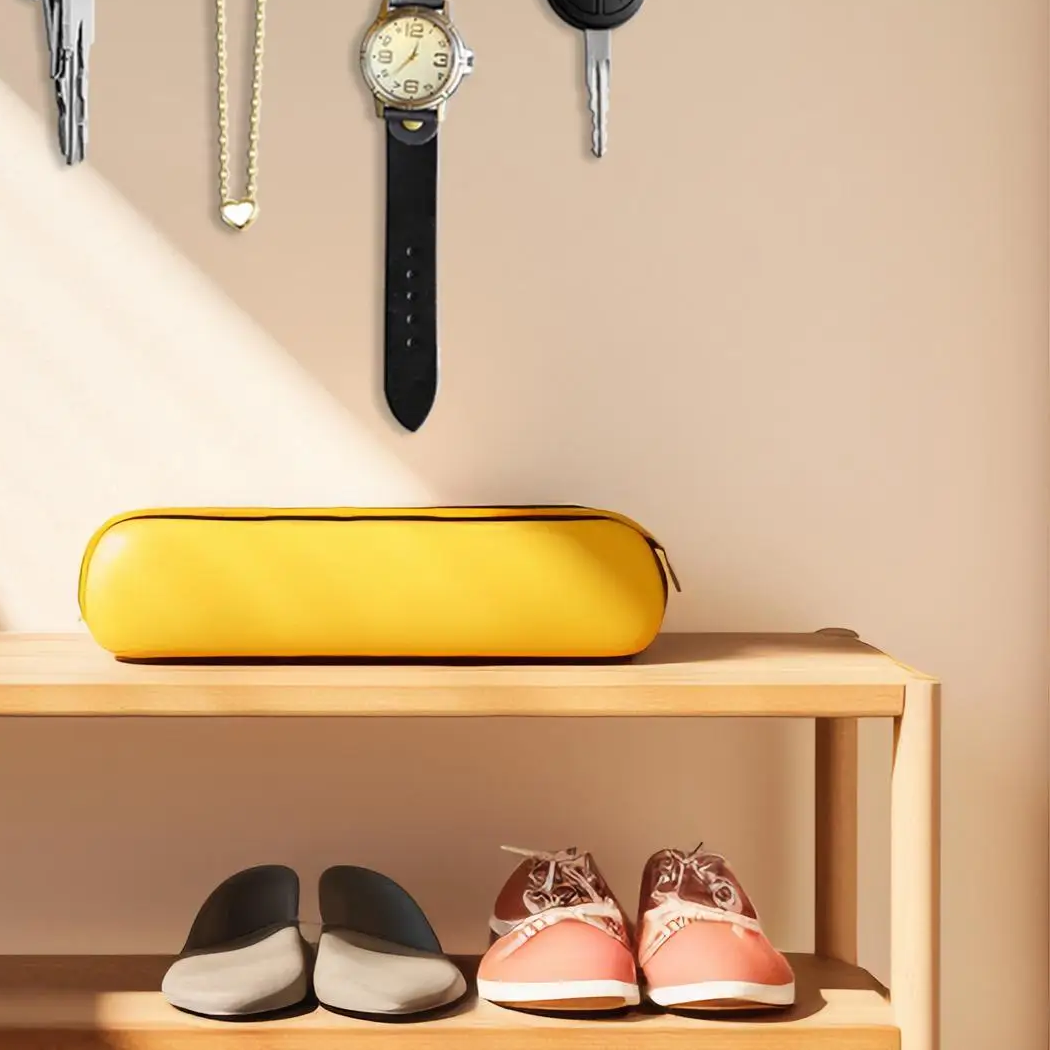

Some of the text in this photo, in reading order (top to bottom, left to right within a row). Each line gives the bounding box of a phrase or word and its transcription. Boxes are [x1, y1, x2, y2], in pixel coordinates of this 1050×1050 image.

[405, 22, 424, 39] 12
[433, 53, 449, 68] 3
[403, 79, 419, 94] 6
